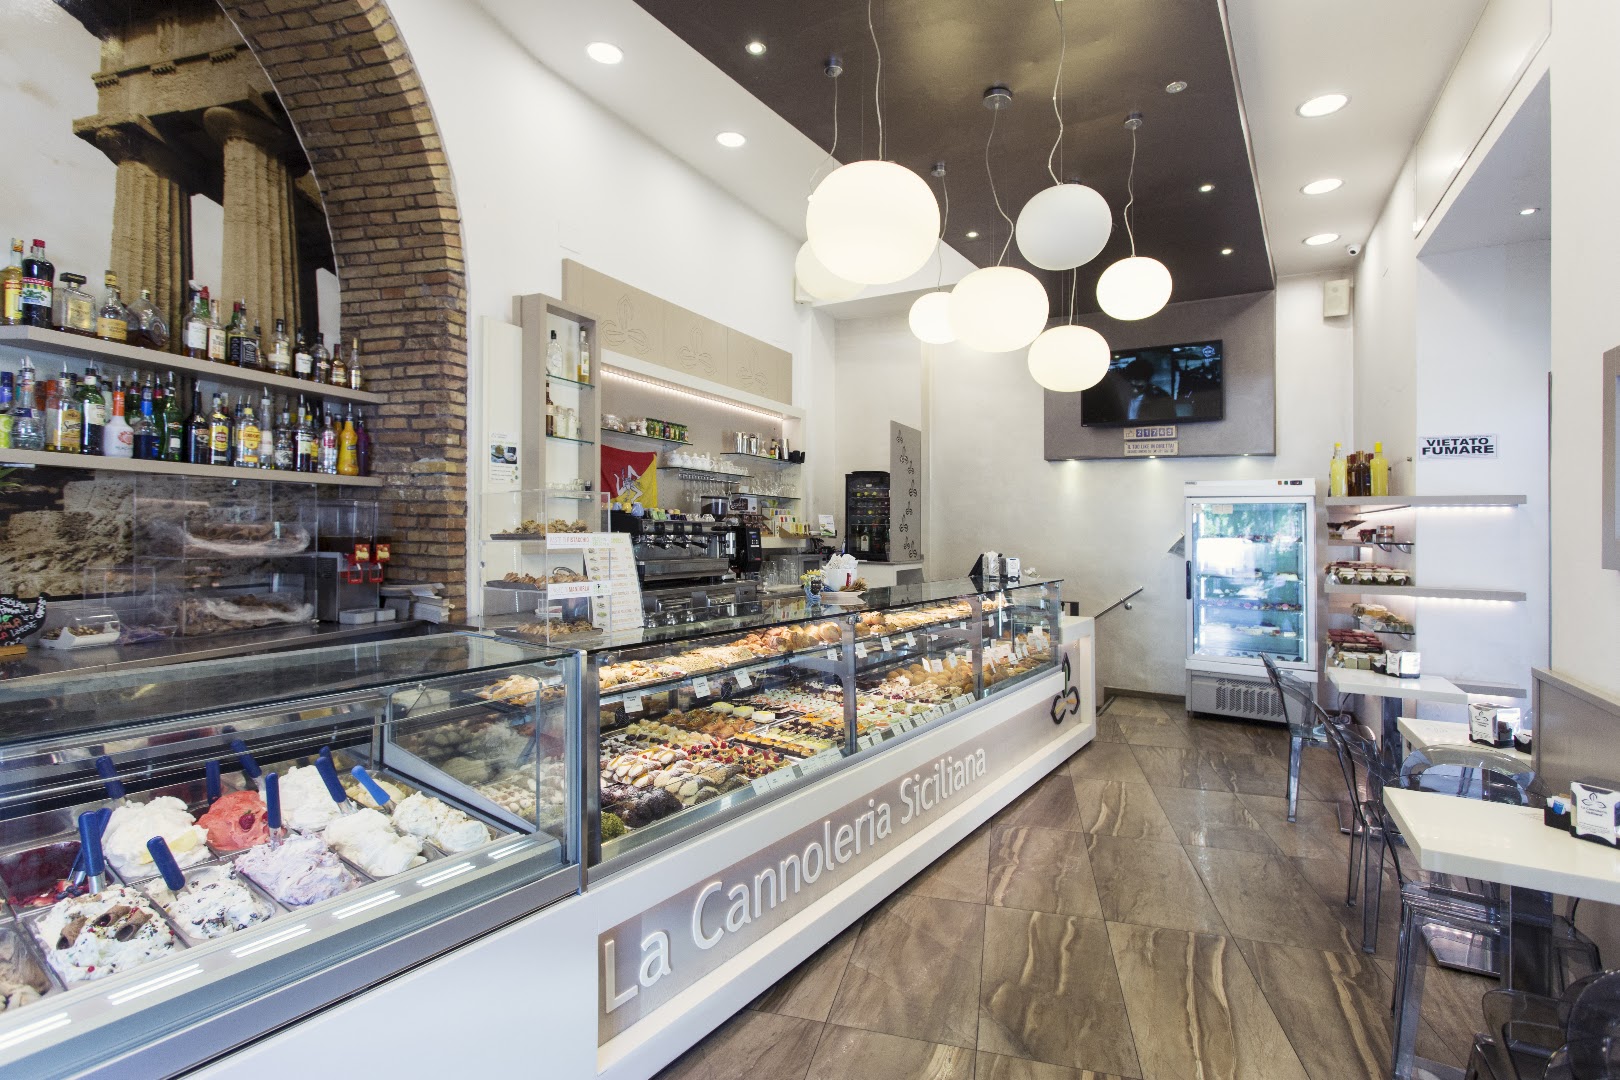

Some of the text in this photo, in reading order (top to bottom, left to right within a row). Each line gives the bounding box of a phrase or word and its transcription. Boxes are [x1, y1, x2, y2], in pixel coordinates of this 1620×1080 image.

[1426, 438, 1489, 446] VIETATO
[1422, 445, 1494, 455] FUMARE
[604, 748, 987, 1014] La Cannoleria Siciliana
